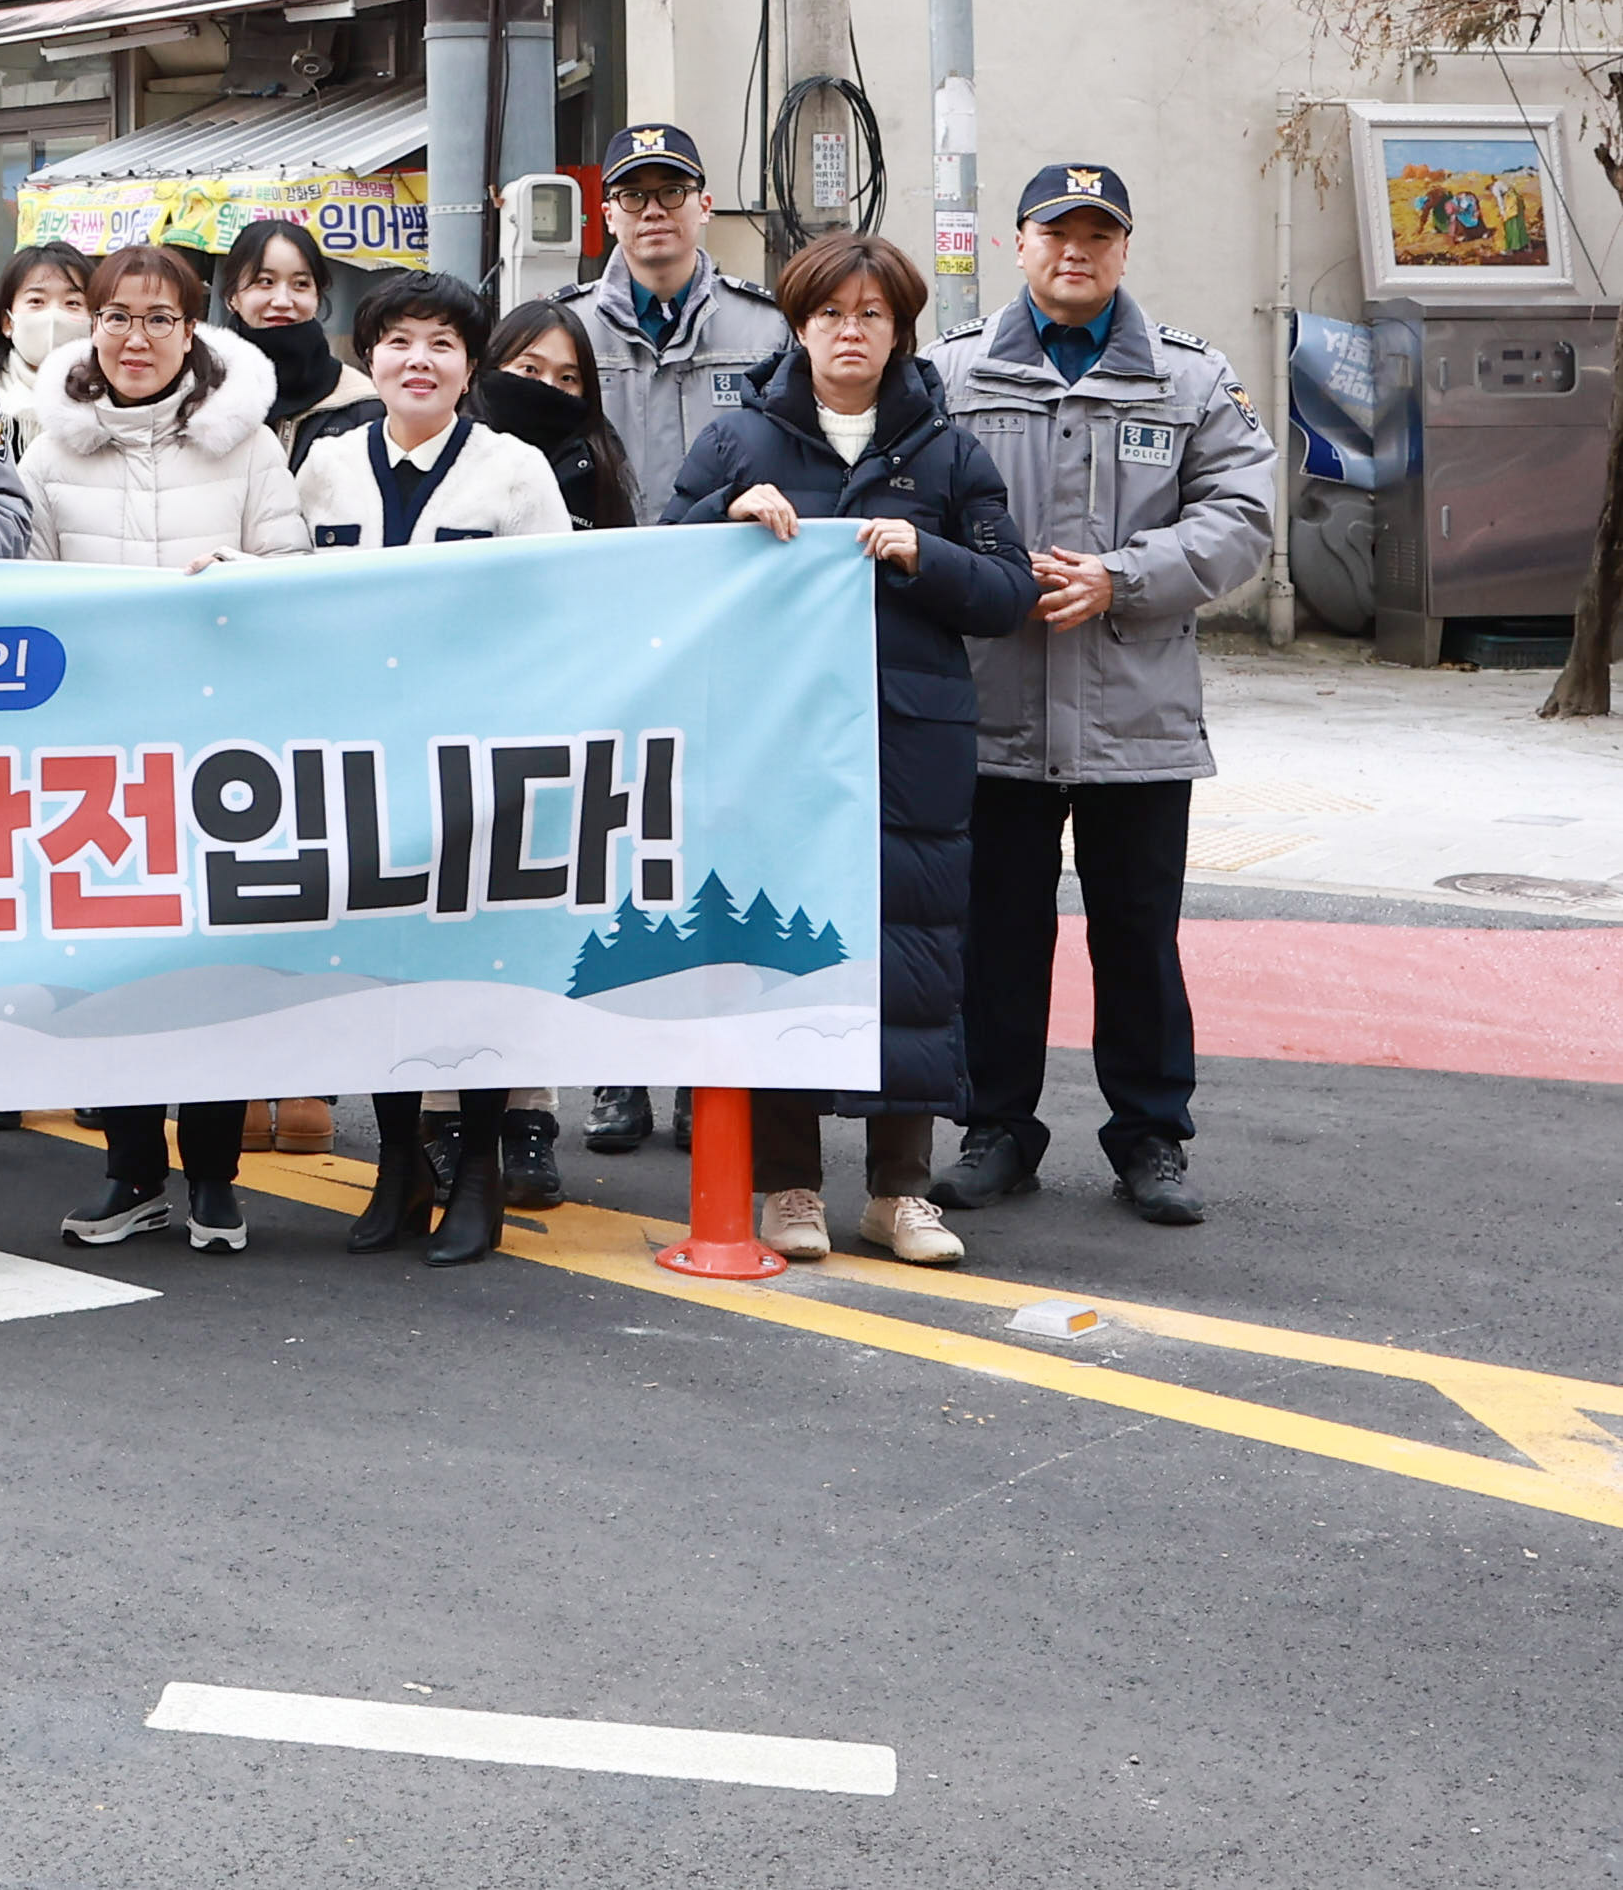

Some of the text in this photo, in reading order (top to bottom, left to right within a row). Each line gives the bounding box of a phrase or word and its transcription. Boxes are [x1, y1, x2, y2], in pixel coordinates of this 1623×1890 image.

[285, 183, 322, 202] 강화된
[319, 203, 429, 250] 잉어빵
[937, 232, 974, 252] 중매
[1124, 447, 1168, 461] POLICE
[889, 476, 916, 491] K2
